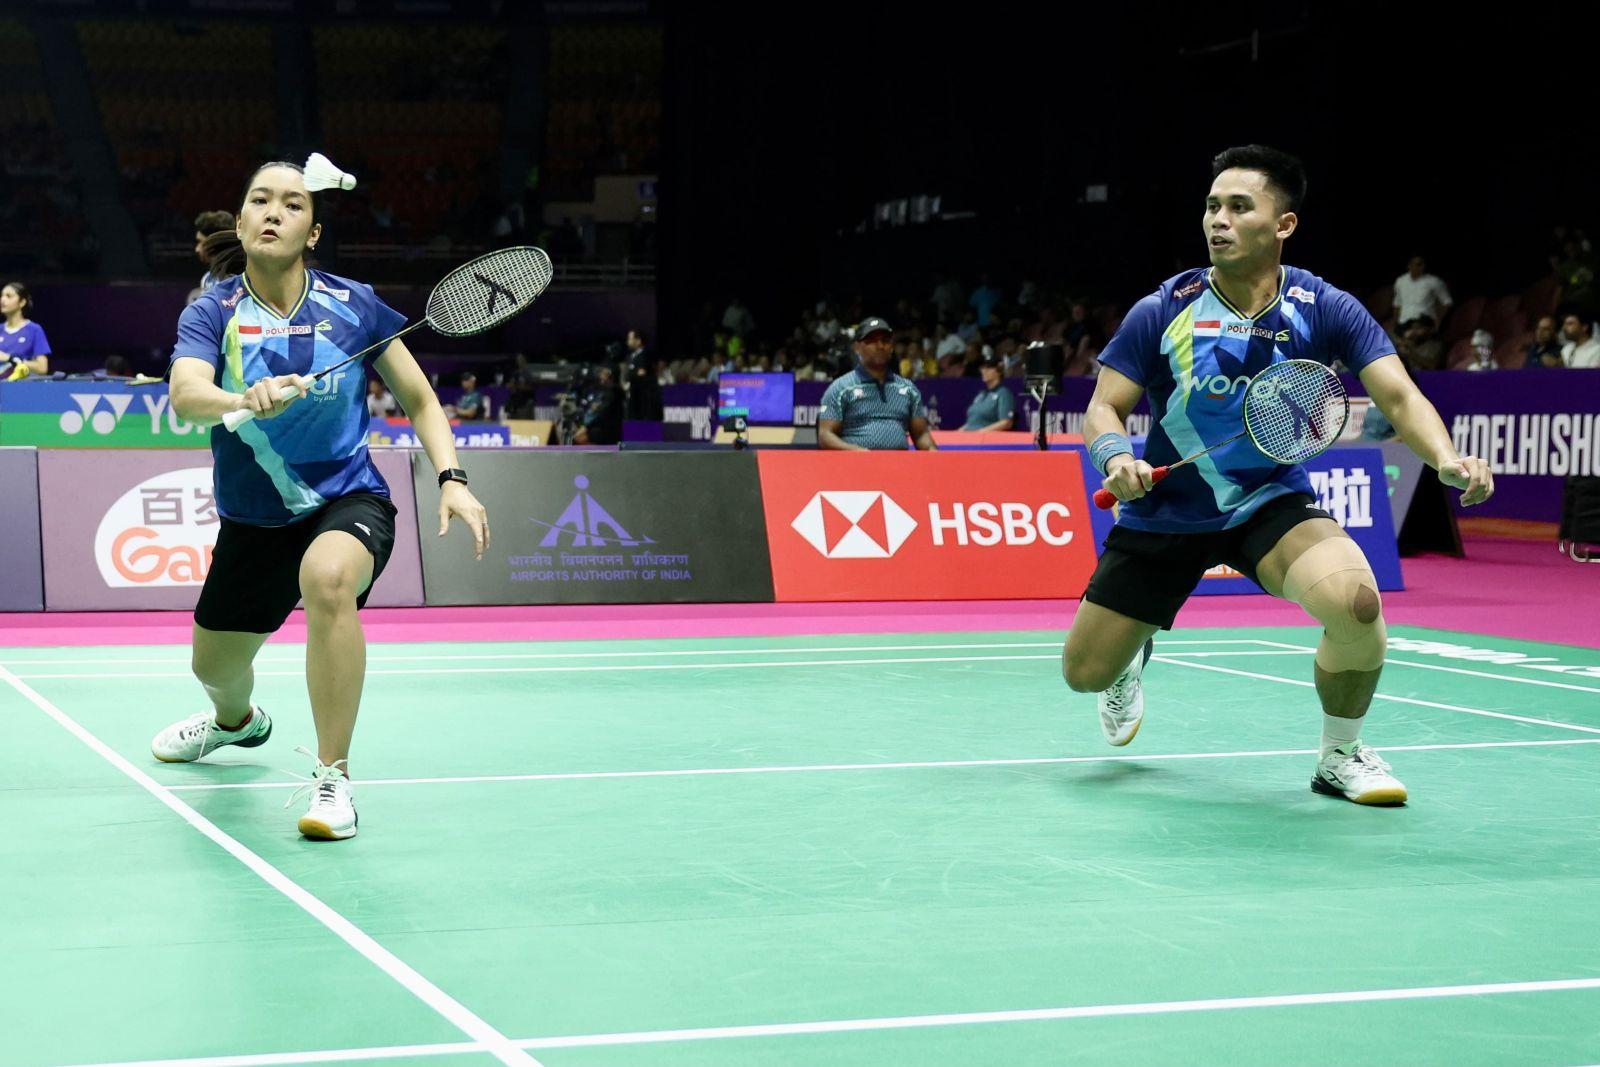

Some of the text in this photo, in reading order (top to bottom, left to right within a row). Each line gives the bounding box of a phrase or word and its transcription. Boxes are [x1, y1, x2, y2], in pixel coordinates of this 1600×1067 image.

[265, 326, 310, 336] POLYTRON
[1227, 325, 1273, 339] POLYTRON
[143, 394, 206, 435] YO
[928, 502, 1073, 546] HSBC
[510, 568, 692, 582] AIRPORTS AUTHORITY OF INDIA
